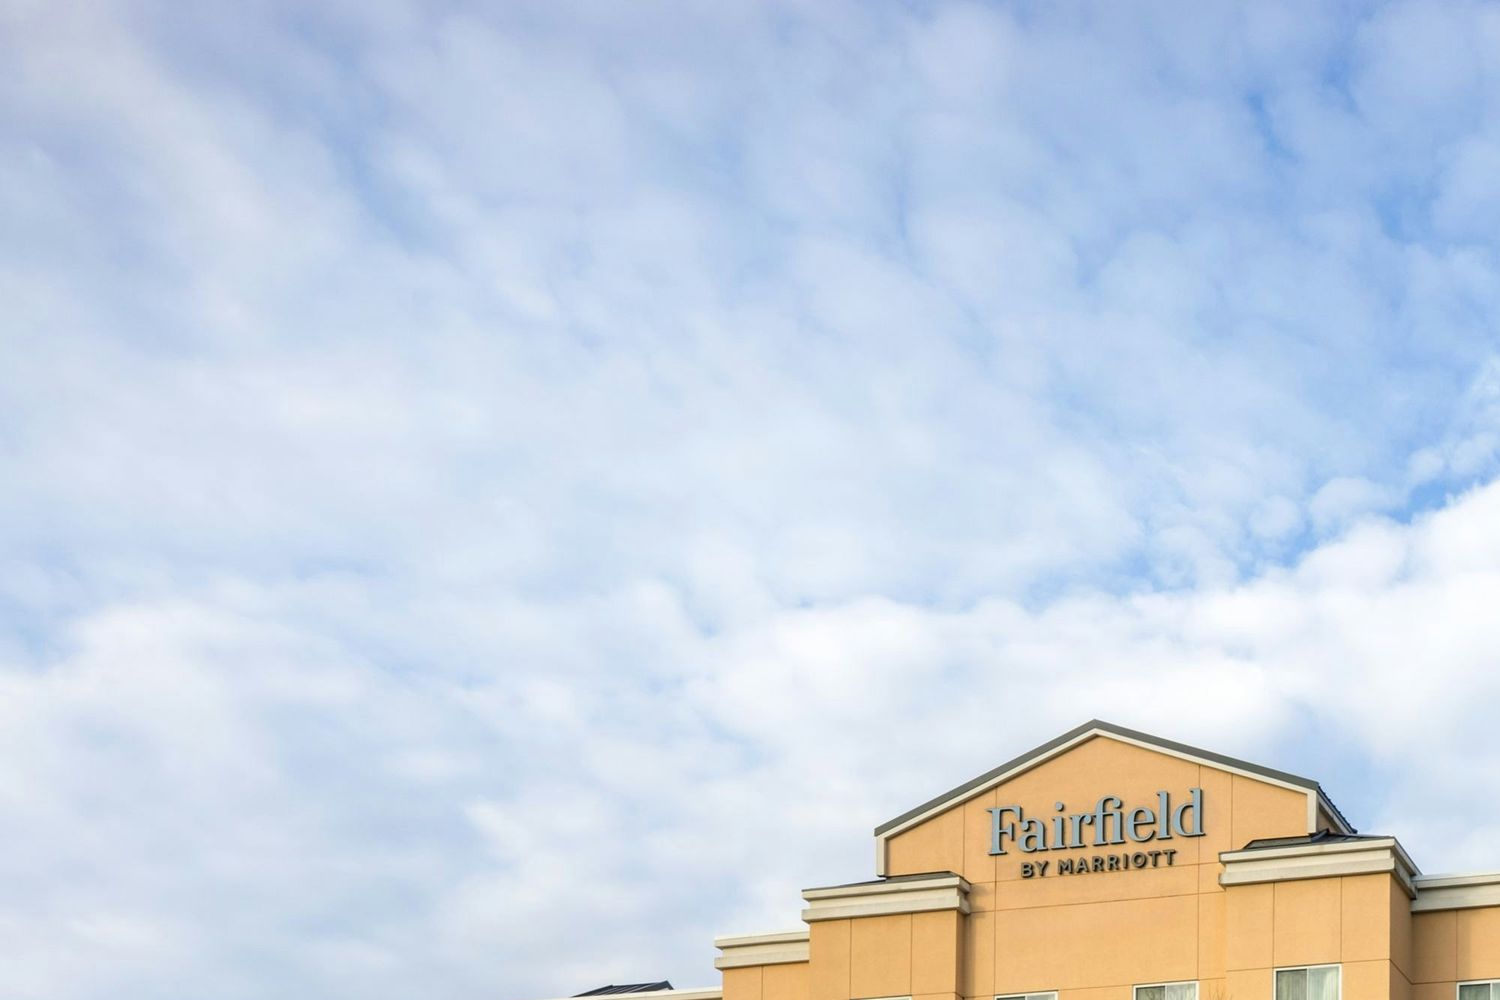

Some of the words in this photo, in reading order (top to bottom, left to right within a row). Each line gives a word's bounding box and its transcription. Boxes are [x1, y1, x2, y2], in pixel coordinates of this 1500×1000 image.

[986, 788, 1206, 856] Fairfield
[1021, 860, 1050, 879] BY
[1058, 849, 1177, 875] MARRIOTT
